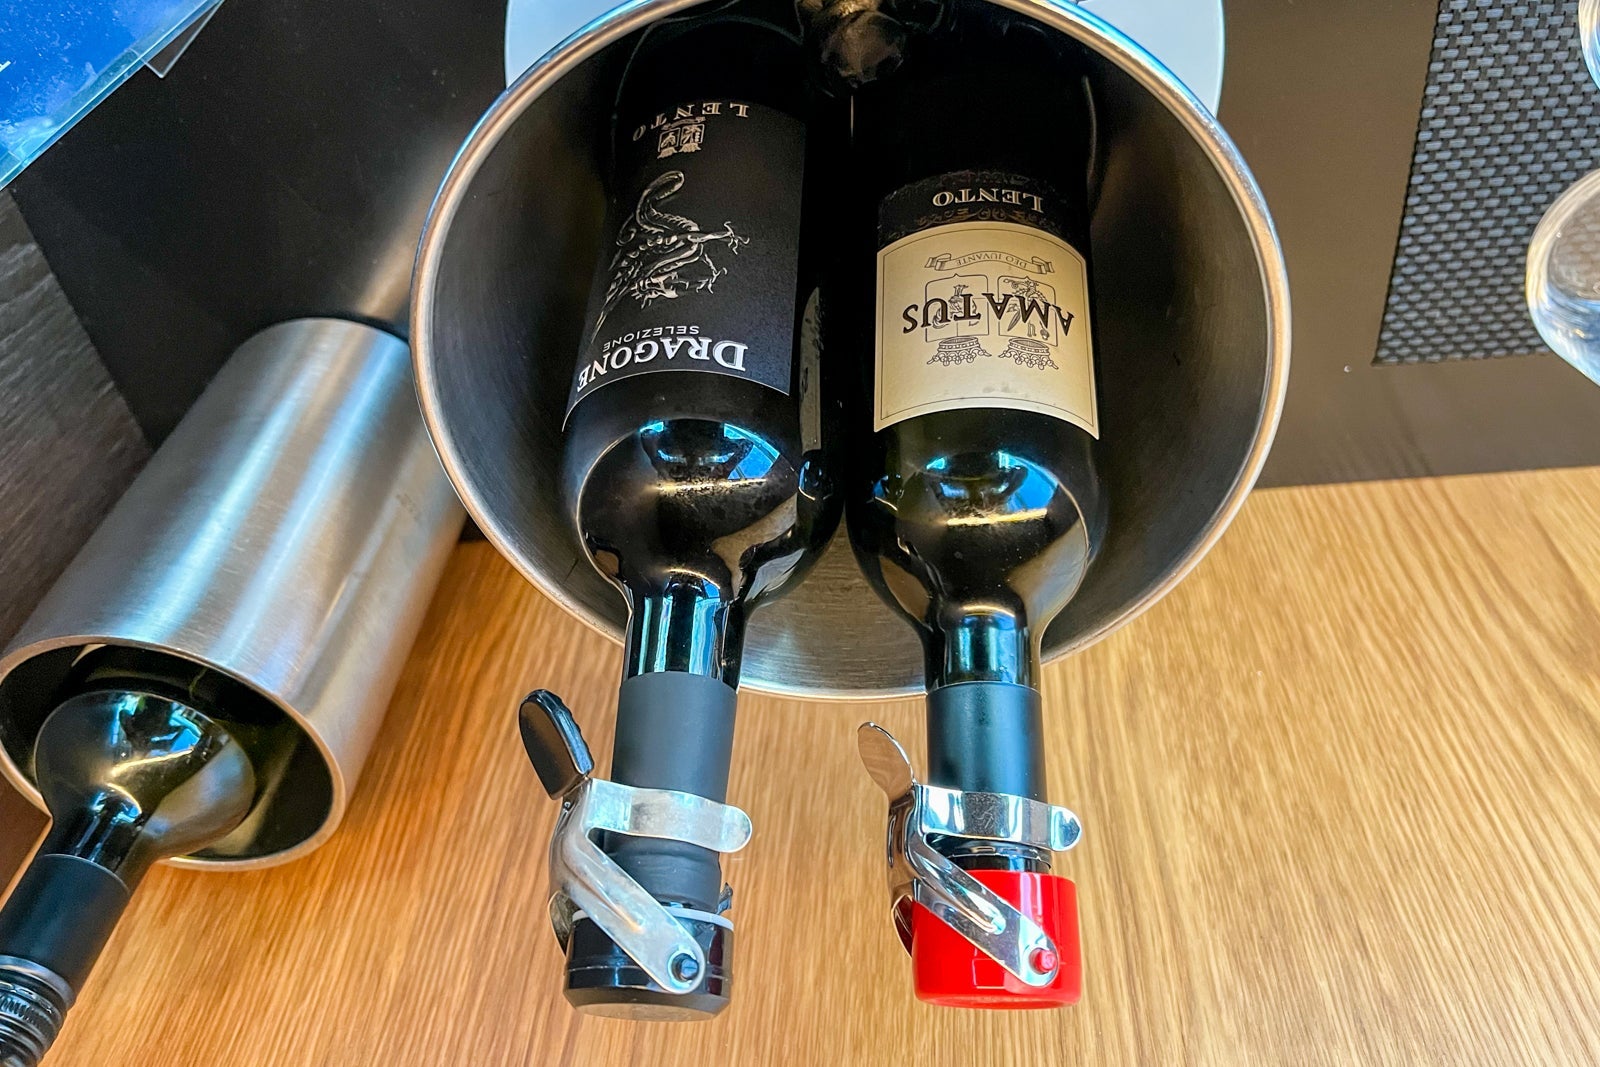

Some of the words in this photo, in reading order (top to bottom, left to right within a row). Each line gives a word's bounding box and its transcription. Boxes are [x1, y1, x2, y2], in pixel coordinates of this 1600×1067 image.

[633, 102, 750, 142] LENTO
[932, 188, 1044, 214] LENTO
[1005, 256, 1028, 269] DEO
[902, 293, 1075, 336] AMATUS
[603, 325, 700, 353] SELEZIONE
[576, 336, 749, 392] DRAGONE
